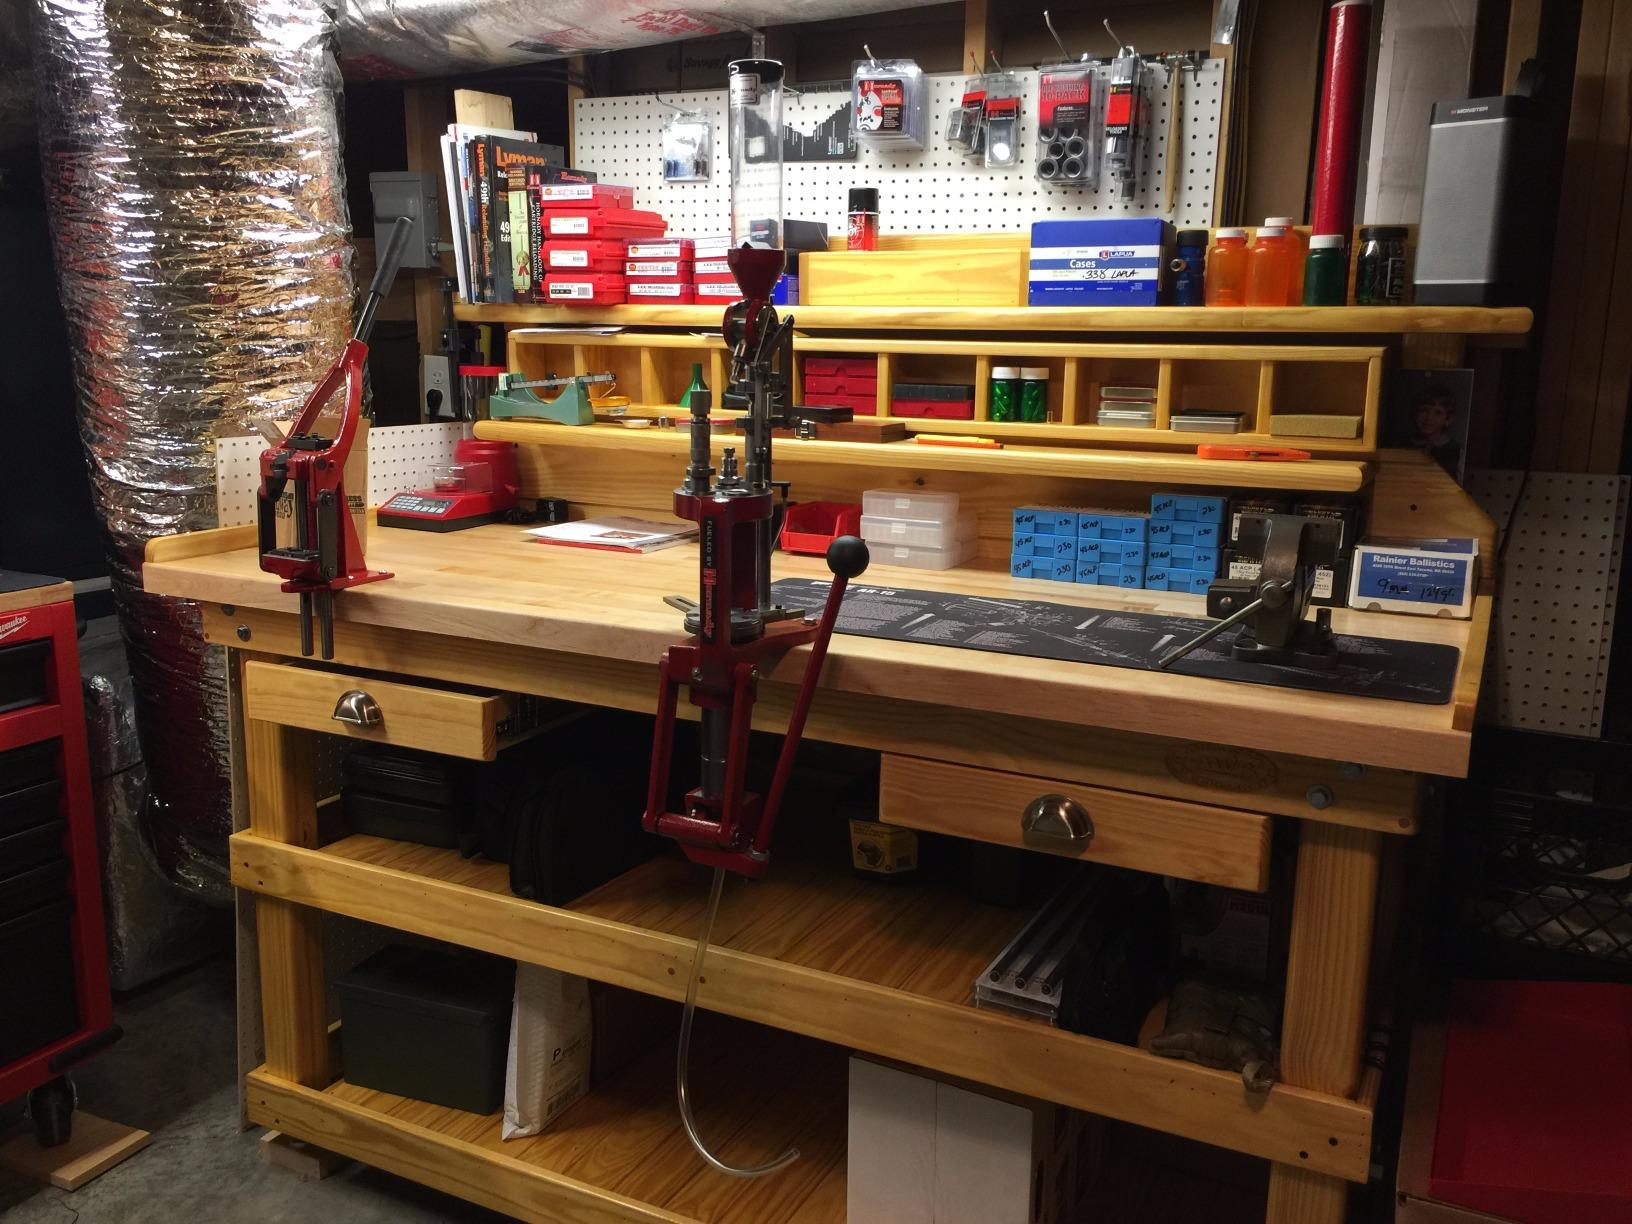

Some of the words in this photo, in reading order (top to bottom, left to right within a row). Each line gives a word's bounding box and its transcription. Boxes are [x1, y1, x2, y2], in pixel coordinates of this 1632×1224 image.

[1069, 259, 1096, 269] Cases
[1372, 554, 1409, 565] Rainier
[1409, 557, 1455, 569] Ballistics
